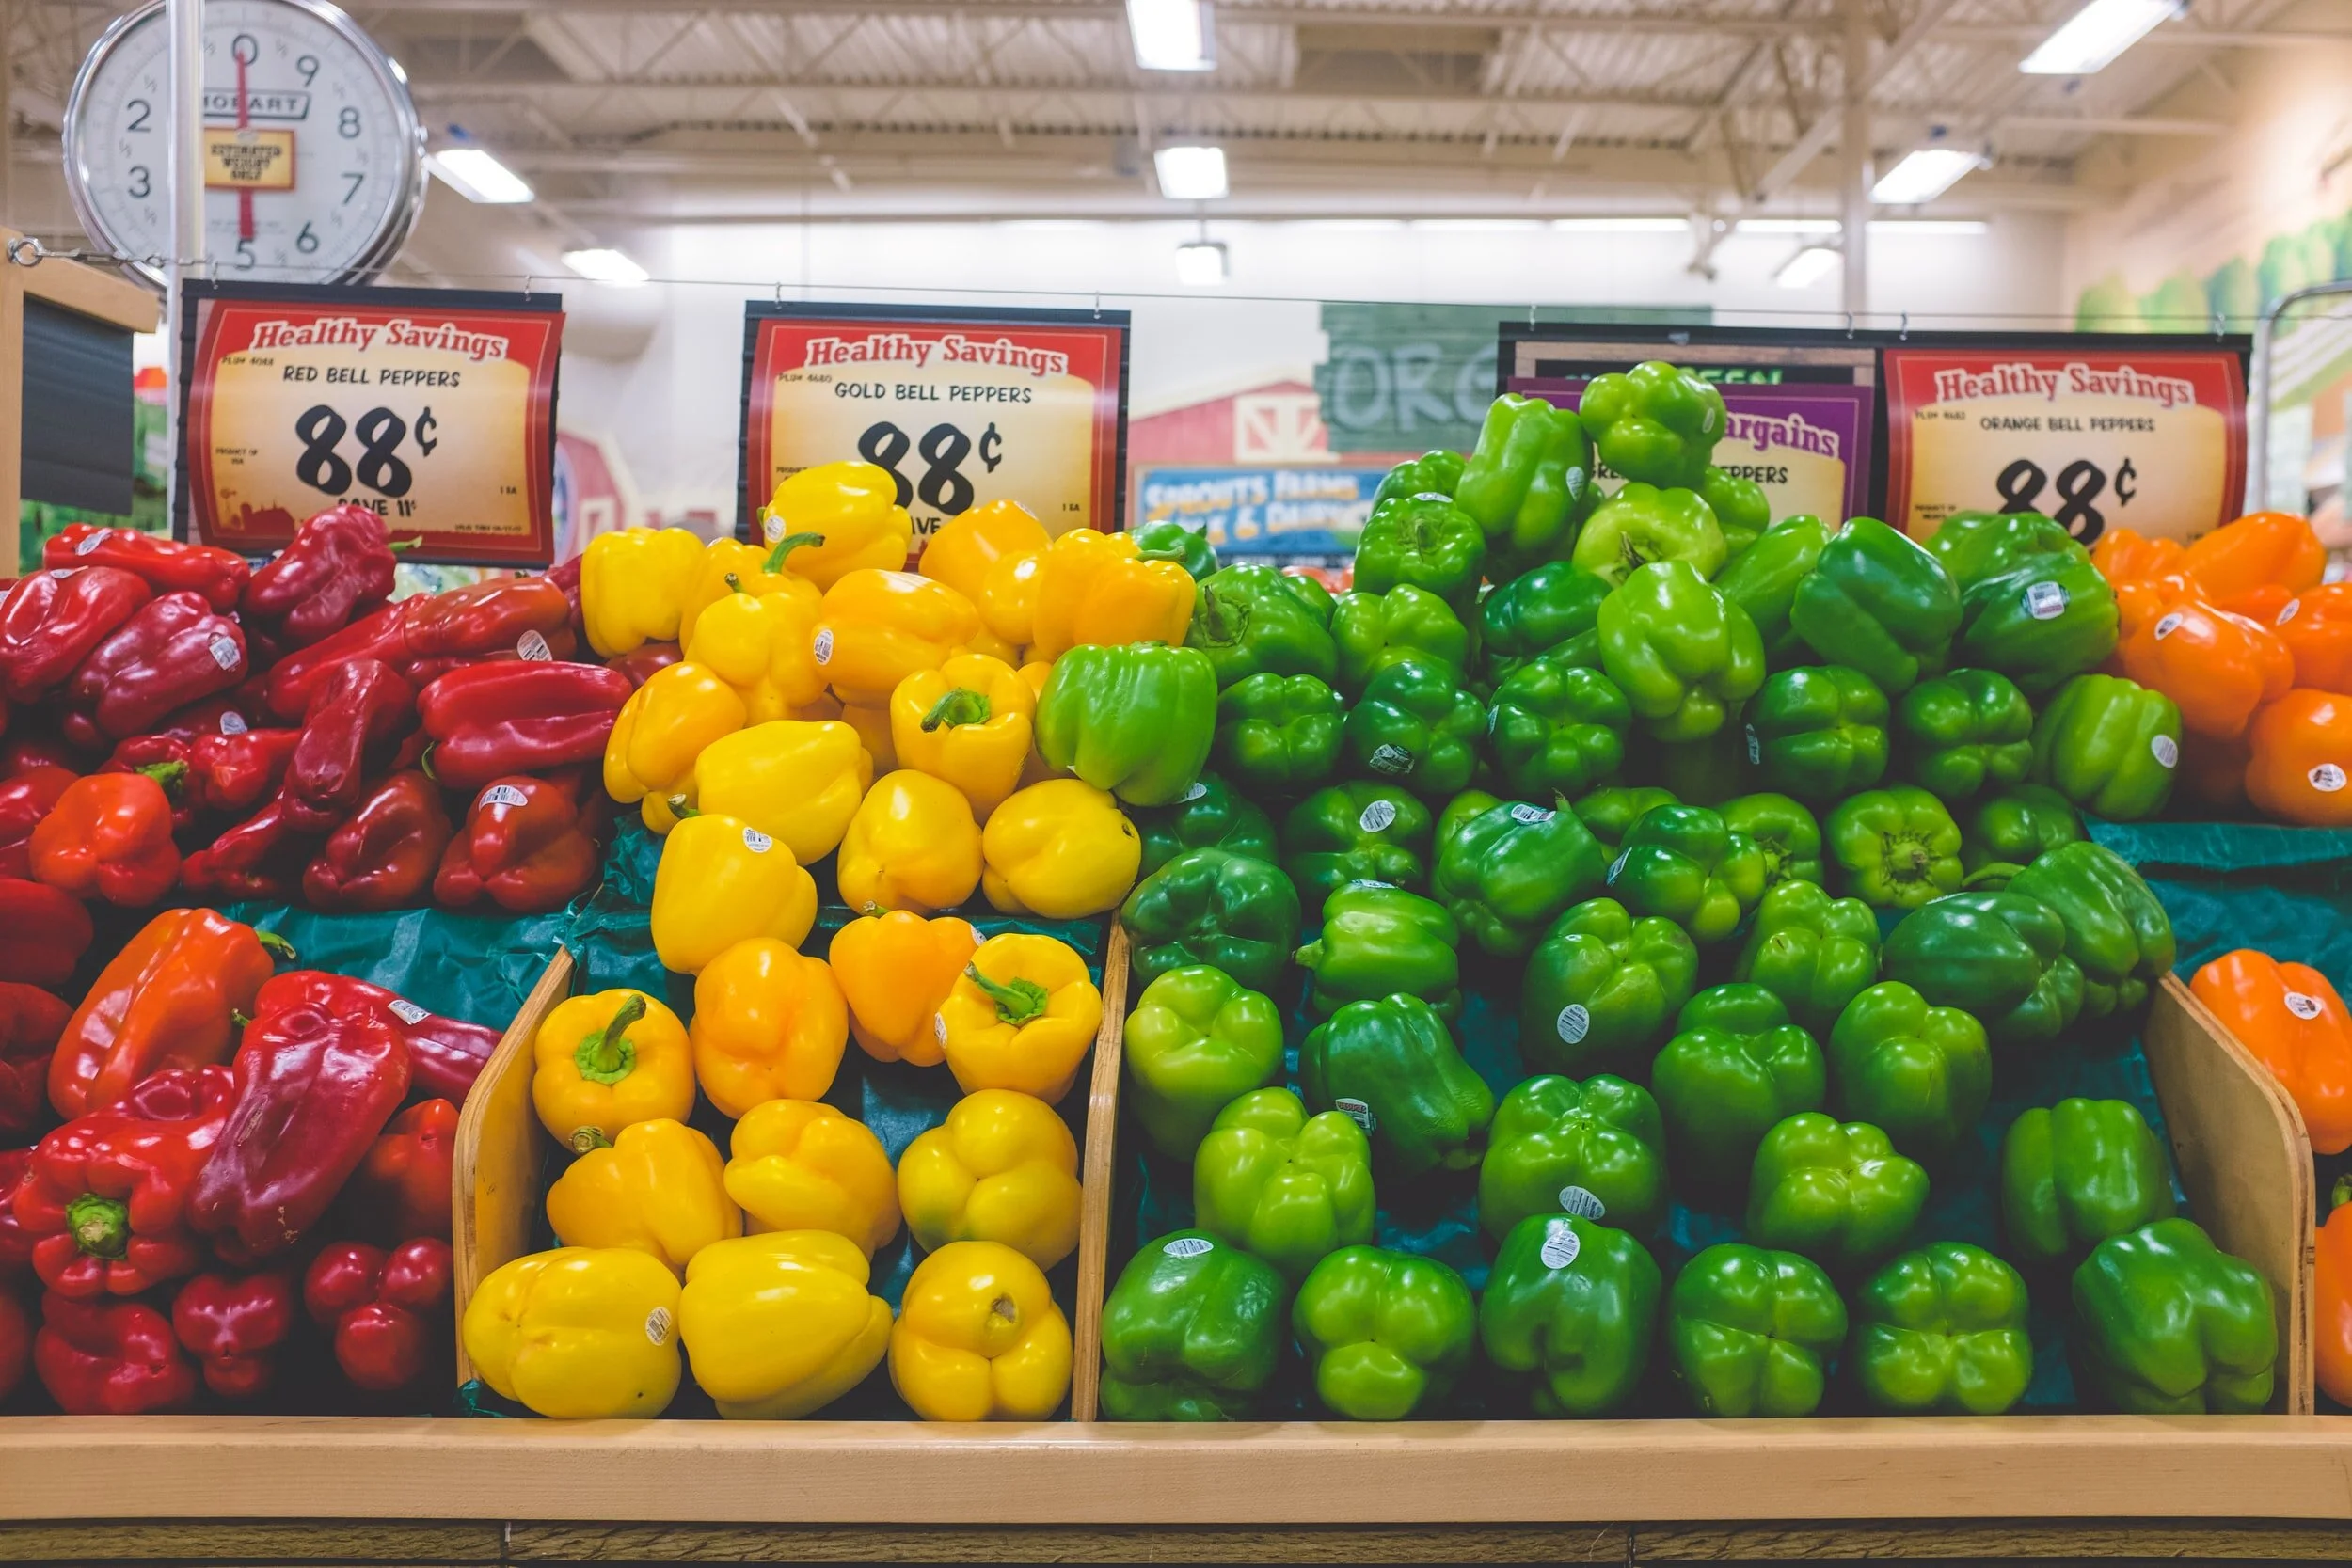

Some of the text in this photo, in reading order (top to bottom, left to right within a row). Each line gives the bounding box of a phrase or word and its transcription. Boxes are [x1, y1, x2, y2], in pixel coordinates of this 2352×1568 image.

[232, 34, 258, 66] 0
[296, 55, 320, 87] 9
[126, 100, 151, 133] 2
[339, 107, 361, 139] 8
[129, 166, 151, 199] 3
[342, 173, 365, 205] 7
[297, 221, 319, 254] 6
[235, 238, 256, 270] 5
[253, 321, 503, 361] Healthy Savings
[810, 337, 1063, 376] Healthy Savings
[283, 365, 461, 388] RED BELL PEPPERS
[834, 381, 1032, 404] GOLD BELL PEPPERS
[1941, 368, 2189, 408] Healthy Savings
[1727, 417, 1835, 457] rgains
[1980, 416, 2155, 433] ORANGE BELL PEPPERS
[1720, 466, 1788, 483] PPERS
[910, 516, 942, 535] VE
